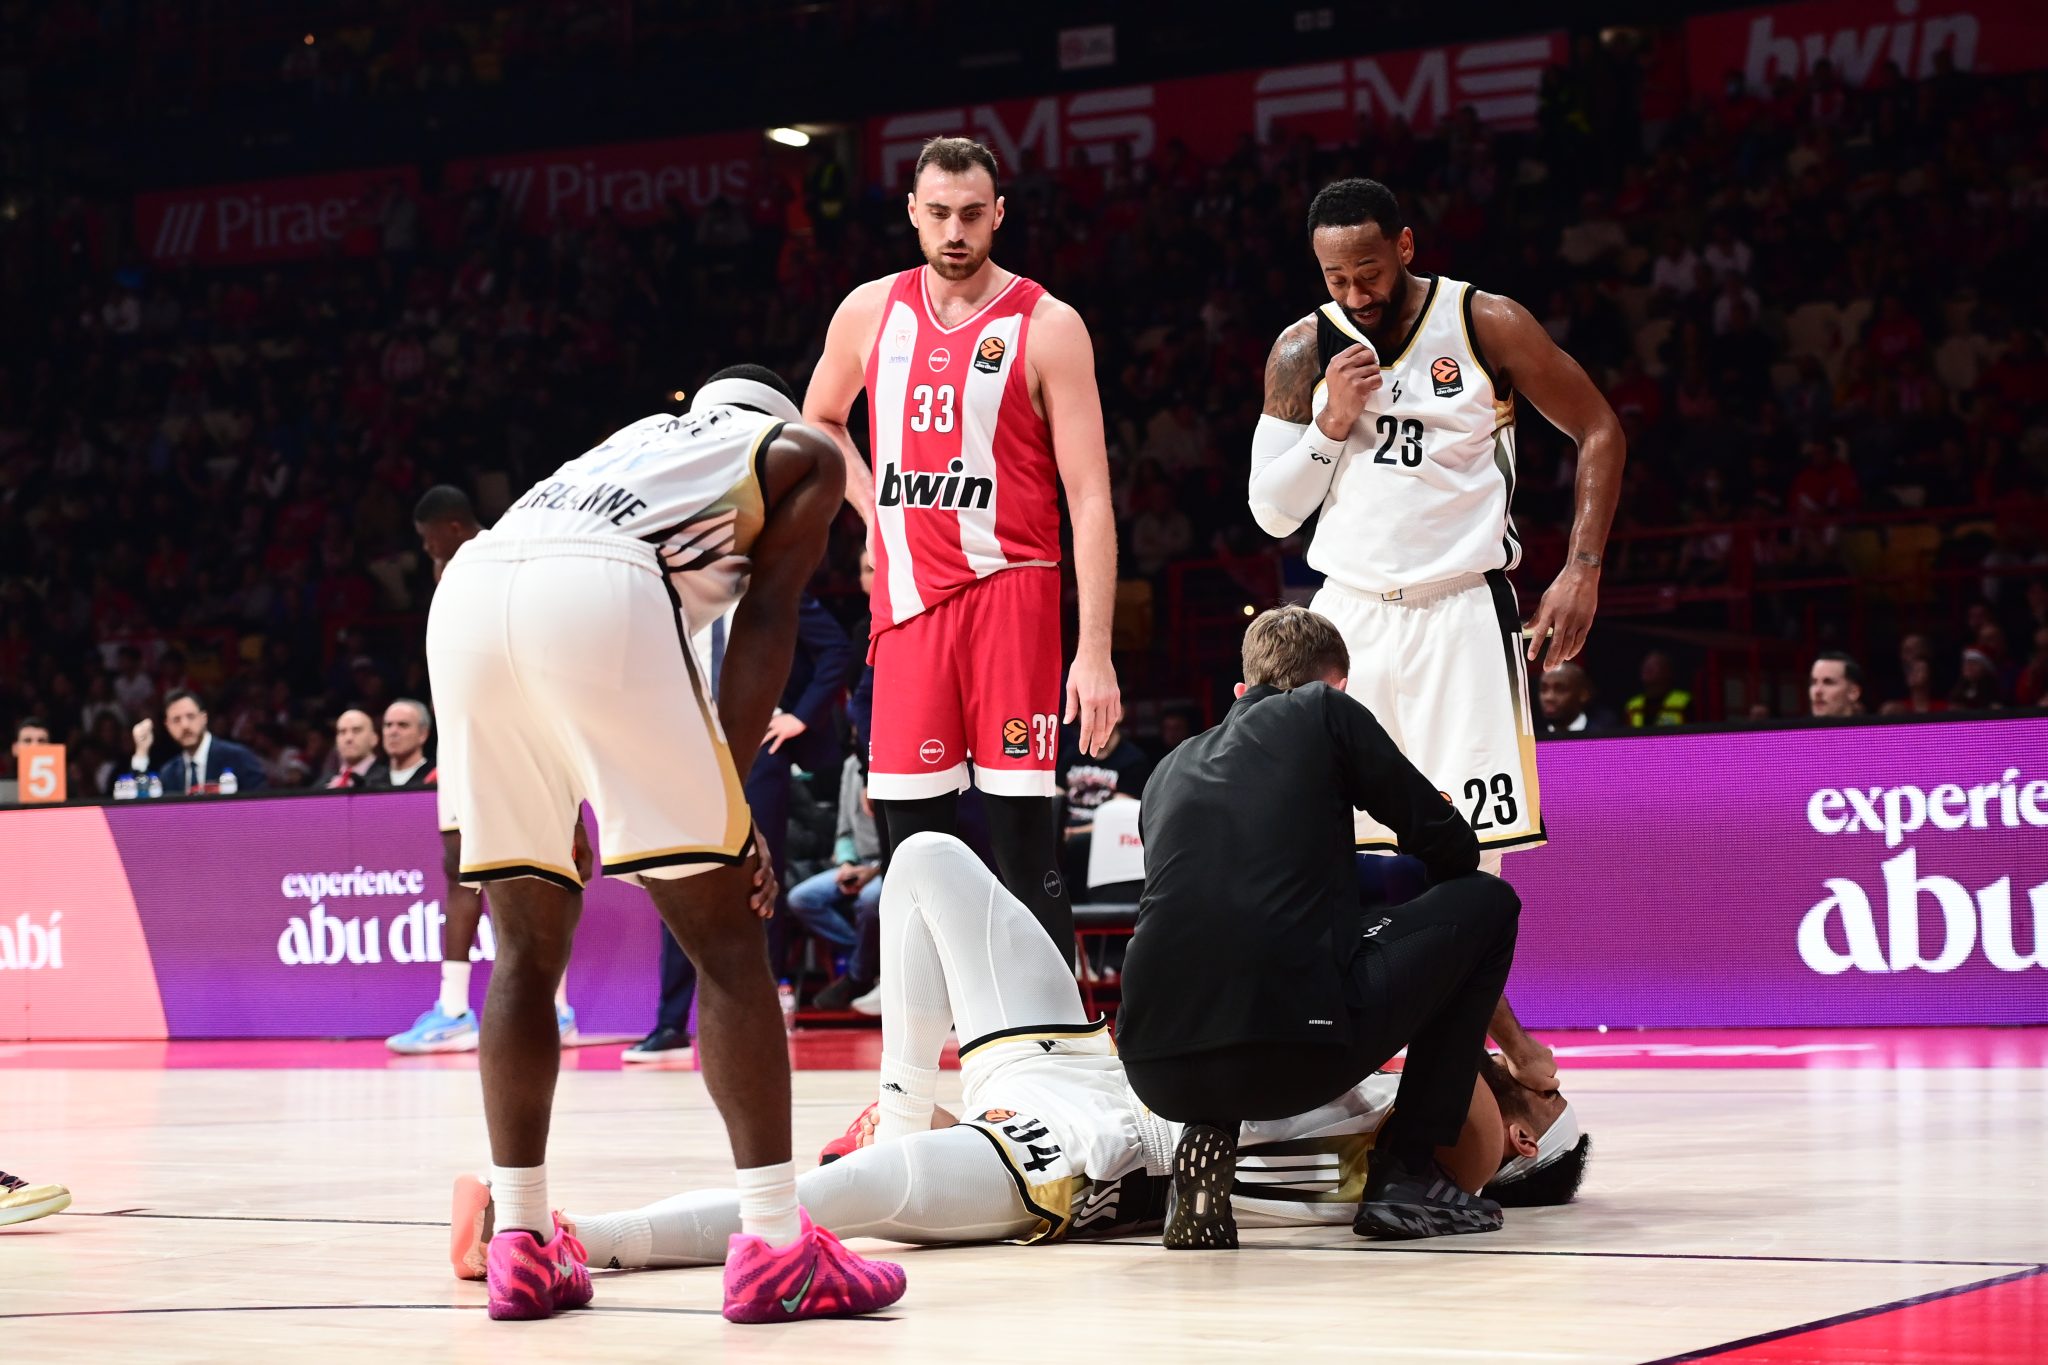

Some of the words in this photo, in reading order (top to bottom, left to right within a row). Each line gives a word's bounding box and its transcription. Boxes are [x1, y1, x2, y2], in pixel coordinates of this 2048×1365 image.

[1744, 0, 1981, 102] bwin
[544, 158, 752, 219] Piraeus
[215, 194, 362, 252] Pirae
[910, 384, 955, 433] 33
[1374, 415, 1424, 467] 23
[878, 459, 993, 510] bwin
[1032, 713, 1058, 761] 33
[28, 756, 56, 797] 5
[1464, 773, 1518, 831] 23
[281, 865, 424, 903] experience
[1797, 846, 2048, 976] abu
[277, 904, 381, 965] abu
